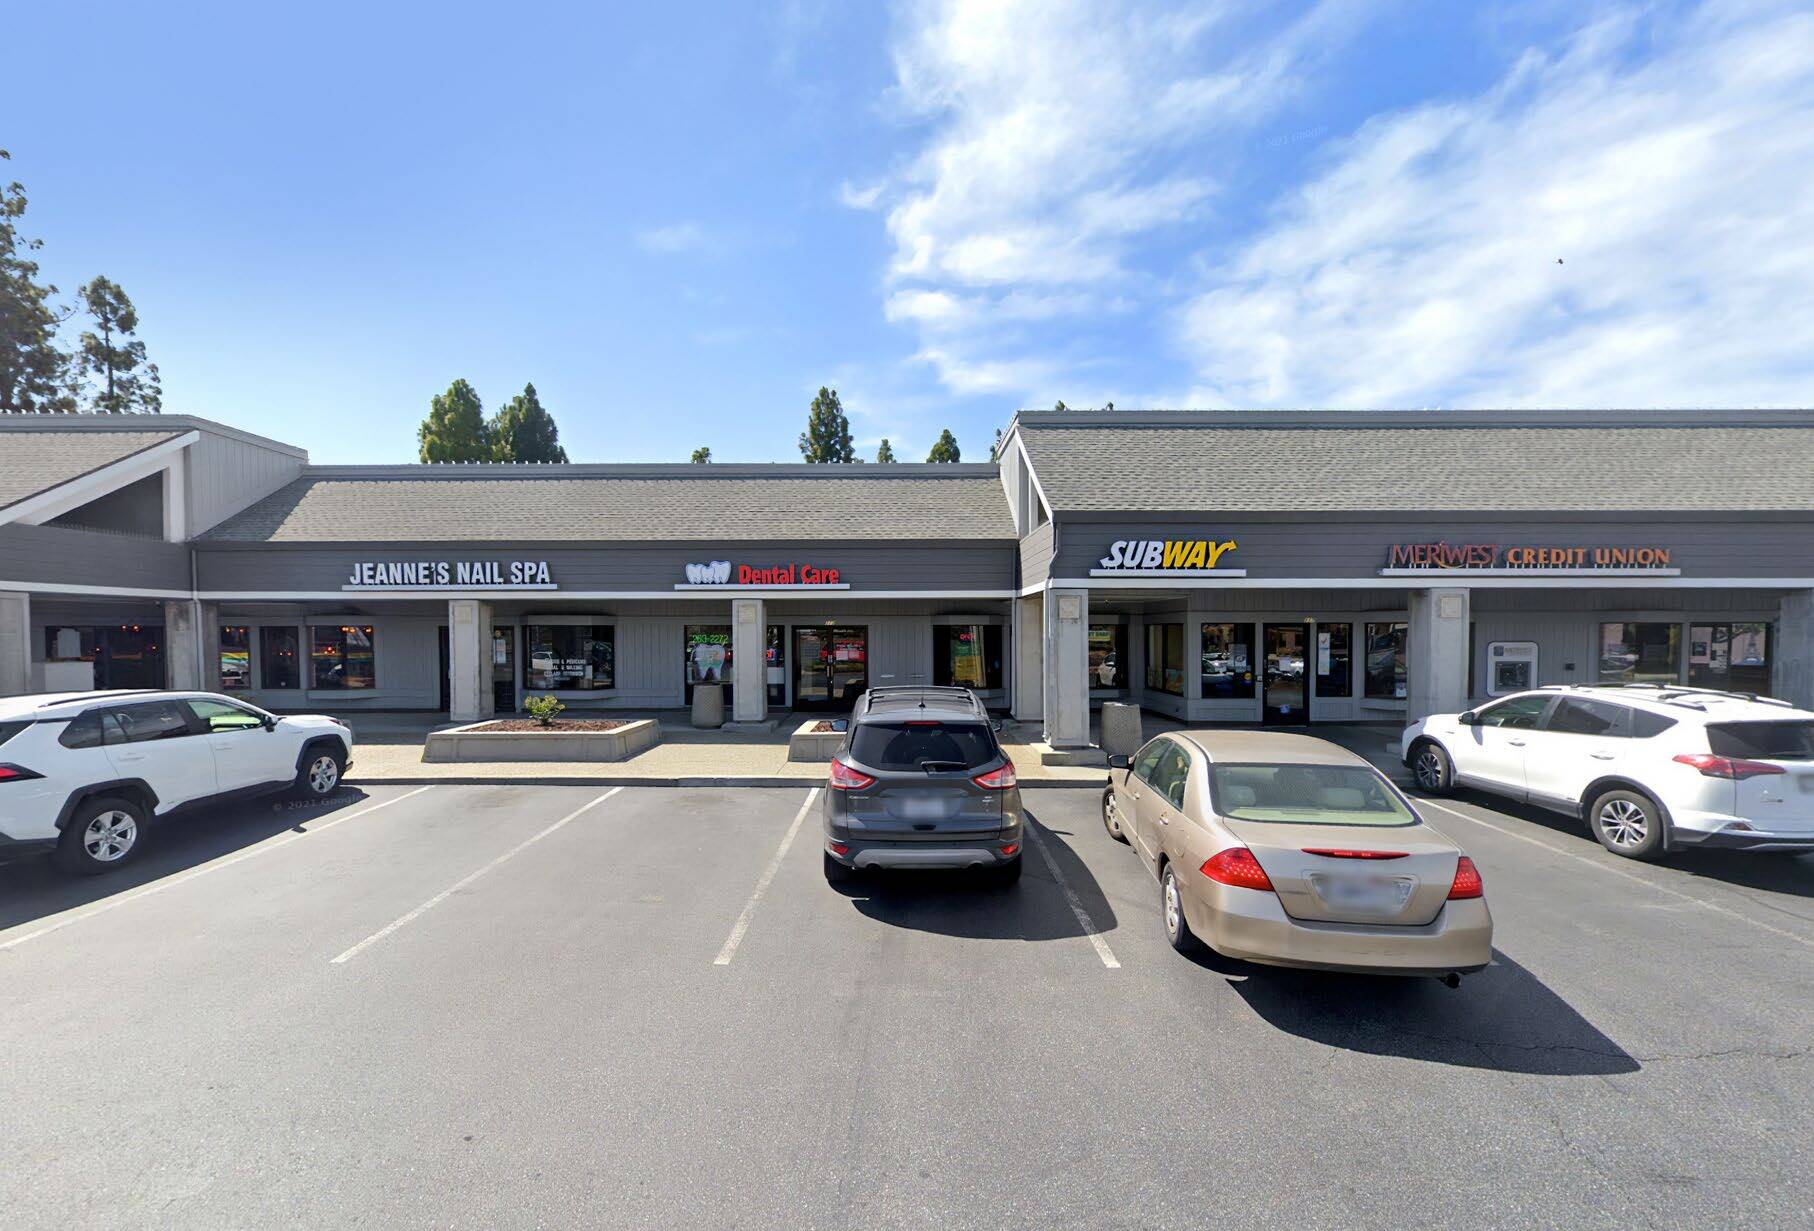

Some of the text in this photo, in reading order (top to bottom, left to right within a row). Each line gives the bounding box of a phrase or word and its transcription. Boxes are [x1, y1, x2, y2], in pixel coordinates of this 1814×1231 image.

[1100, 540, 1237, 568] SUBWAY
[1391, 541, 1670, 567] MERIWEST CREDIT UNION
[349, 562, 550, 584] JEANNE'S NAIL SPA
[738, 562, 839, 584] Dental Care
